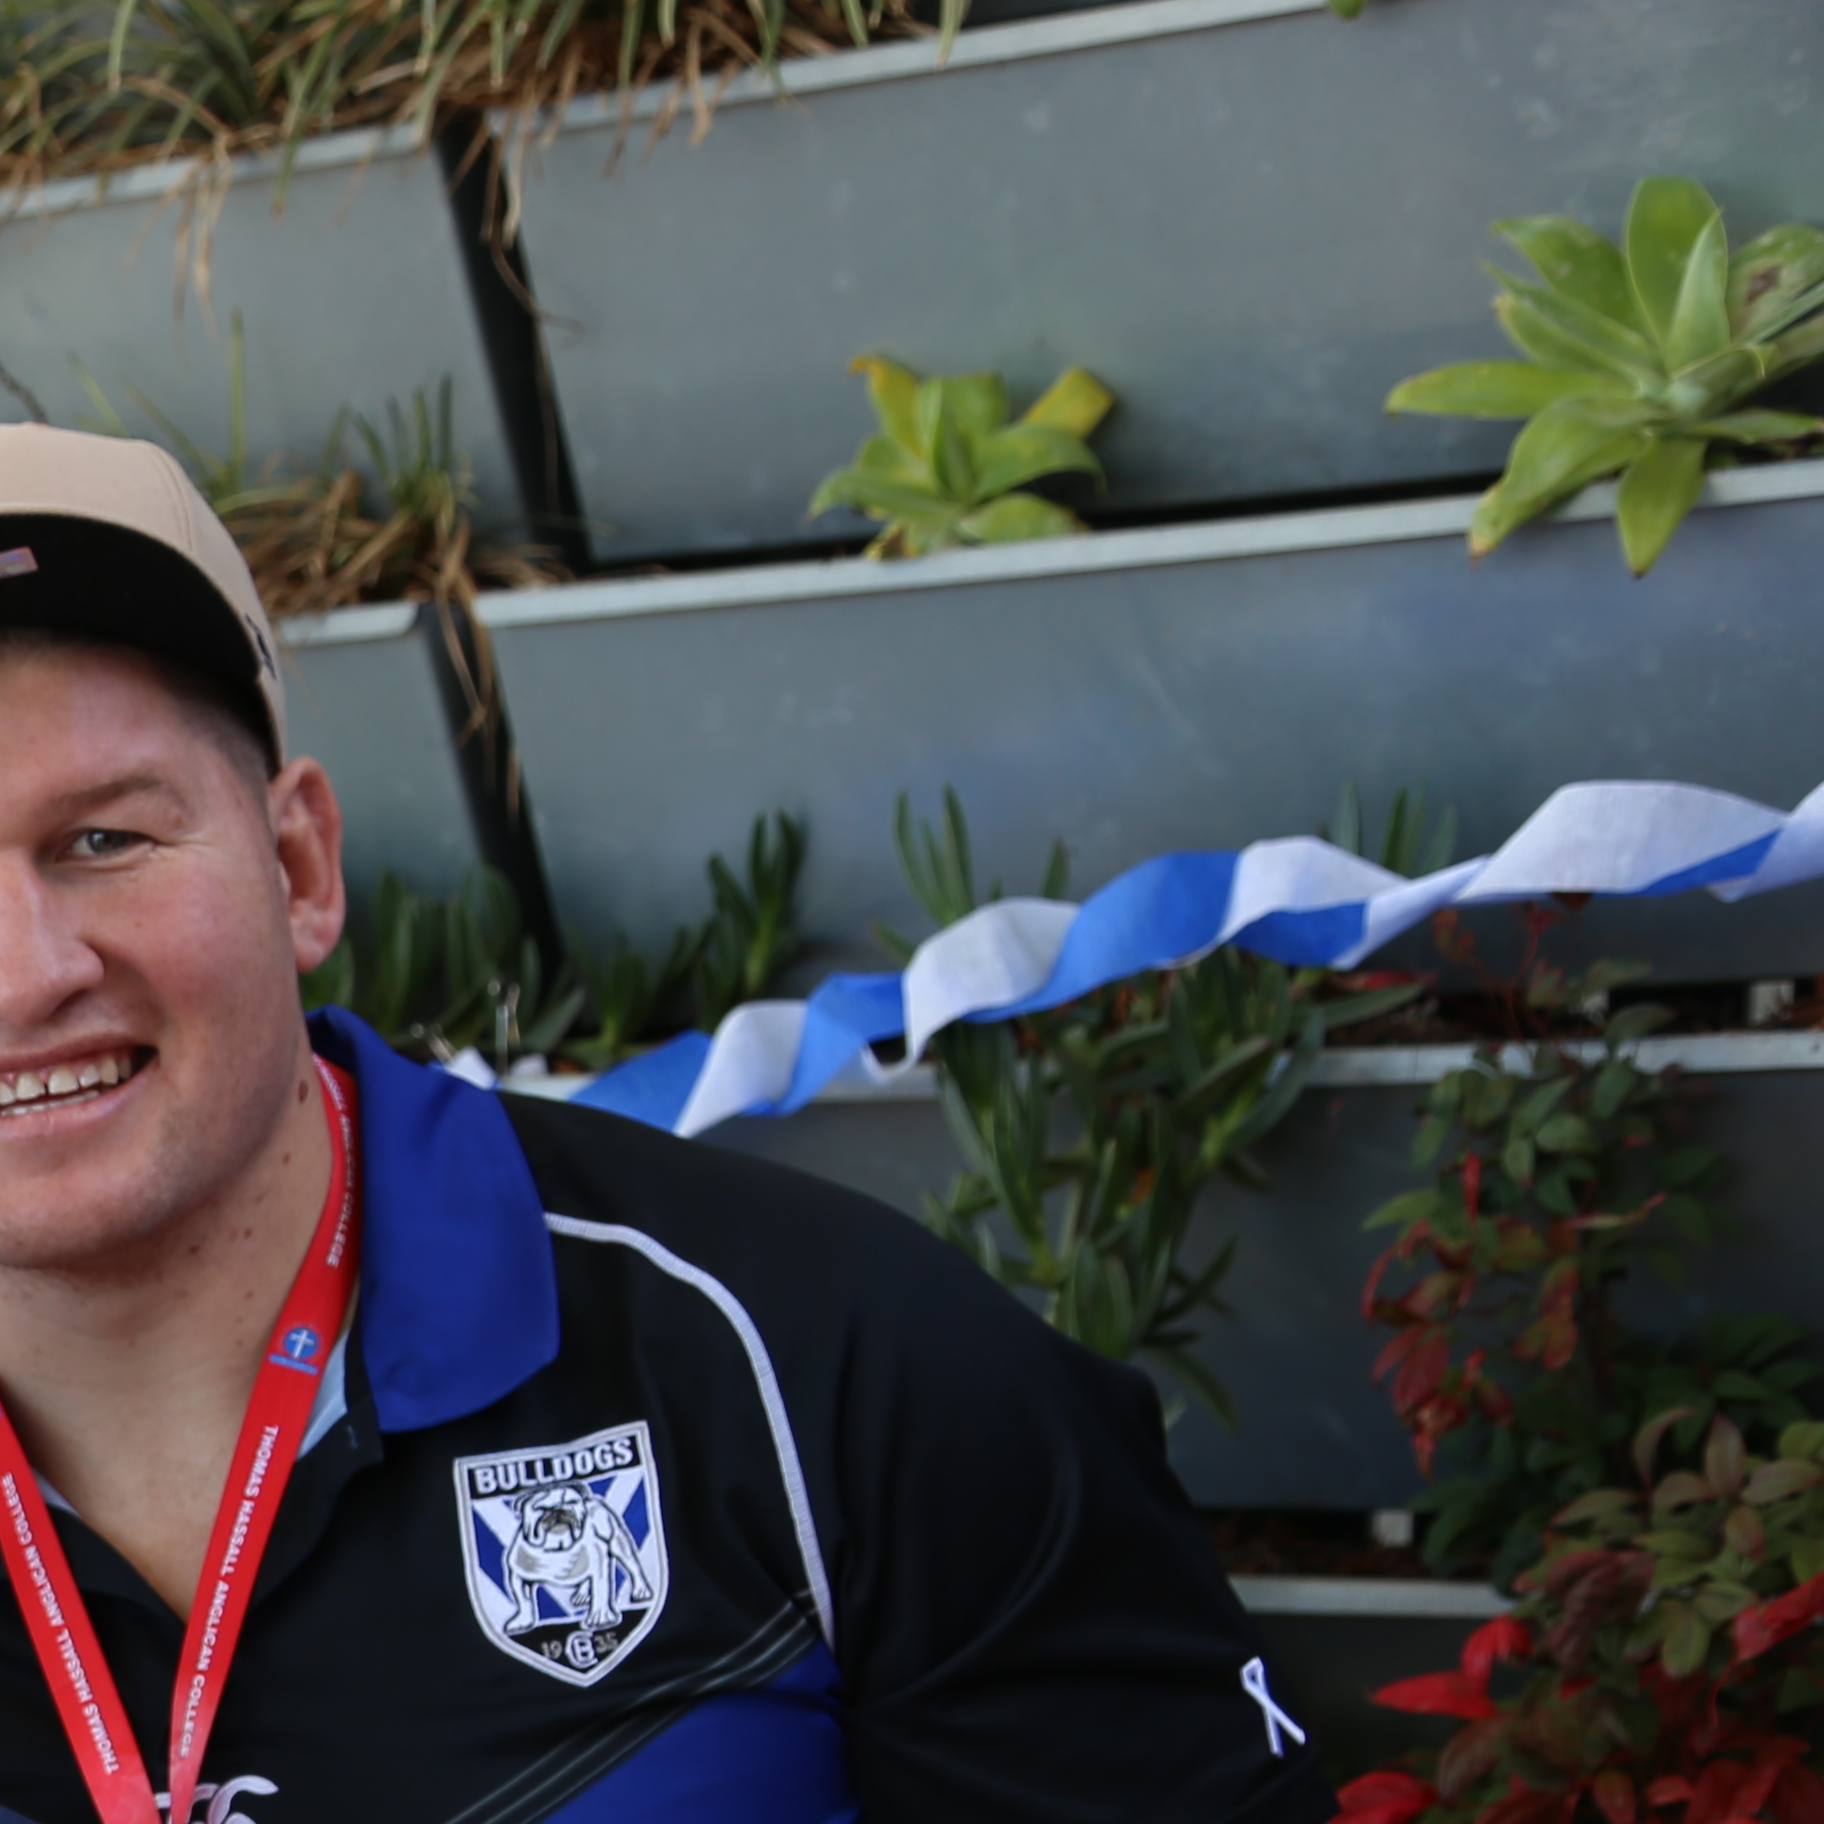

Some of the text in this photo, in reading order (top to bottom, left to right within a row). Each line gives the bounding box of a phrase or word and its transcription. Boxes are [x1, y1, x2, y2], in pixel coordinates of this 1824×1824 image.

[179, 1425, 280, 1759] THOMAS HASSALL ANGLICAN COLLEGE
[475, 1439, 634, 1494] BULLDOGS
[0, 1471, 120, 1775] THOMAS HASSALL ANGLICAN COLLEGE
